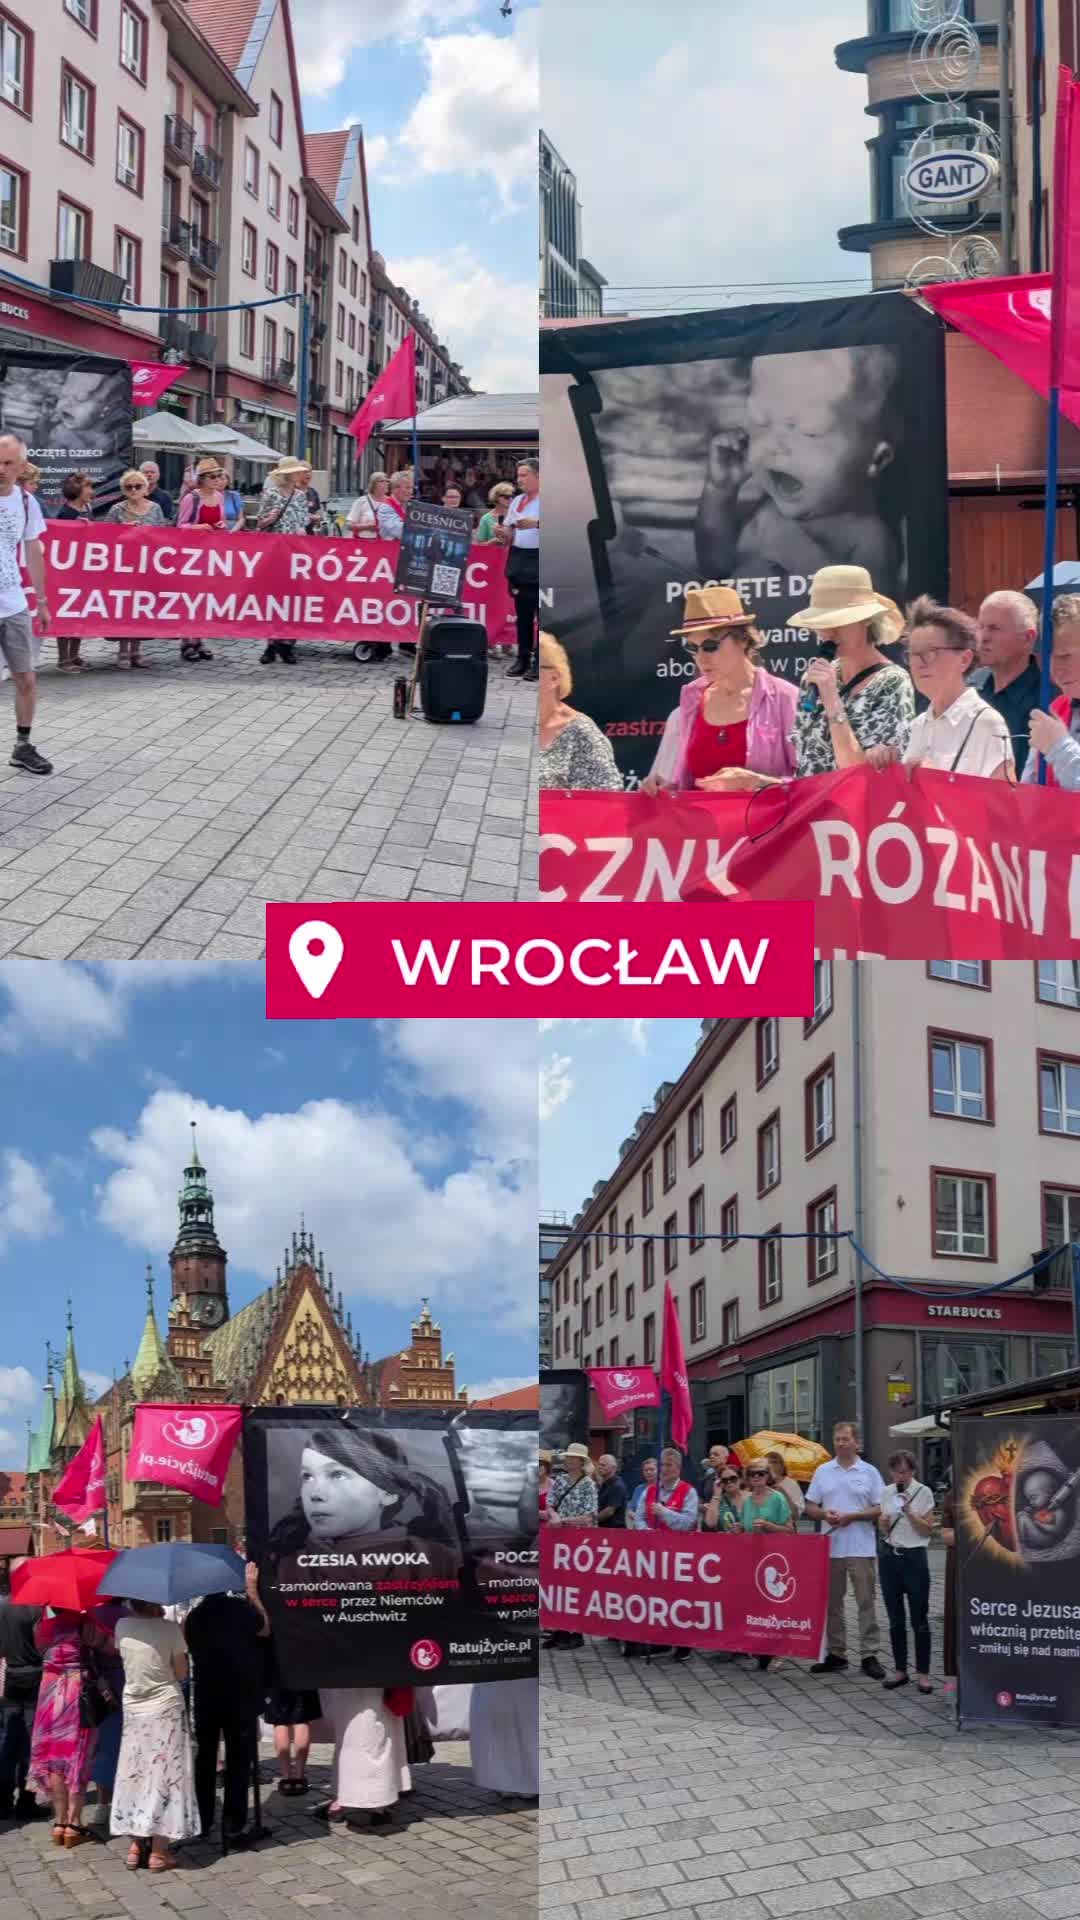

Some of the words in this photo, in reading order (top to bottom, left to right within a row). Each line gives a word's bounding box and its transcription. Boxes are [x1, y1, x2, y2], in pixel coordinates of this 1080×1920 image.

[919, 164, 975, 188] GANT
[26, 448, 66, 459] OCZĘTE
[409, 510, 469, 531] OLEŚNICA
[290, 549, 489, 588] RÓŻAC
[56, 588, 325, 624] ZATRZYMANIE
[334, 597, 487, 627] ABOJI
[928, 1304, 1002, 1320] STARBUCKS
[297, 1553, 357, 1567] CZESIA
[361, 1552, 430, 1566] KWOKA
[495, 1550, 539, 1563] POCZ
[553, 1538, 722, 1584] RÓŻANIEC
[279, 1580, 373, 1592] zamordowana
[341, 1597, 377, 1609] przez
[380, 1594, 444, 1606] Niemców
[970, 1597, 1017, 1617] Serce
[1021, 1600, 1080, 1619] Jezusa
[322, 1613, 335, 1622] w
[338, 1610, 407, 1622] Auschwitz
[497, 1610, 510, 1619] w
[585, 1589, 724, 1631] ABORCJI
[970, 1622, 1027, 1641] włócznią
[449, 1639, 531, 1655] RatujŻycie.pl
[1031, 1645, 1051, 1656] nad
